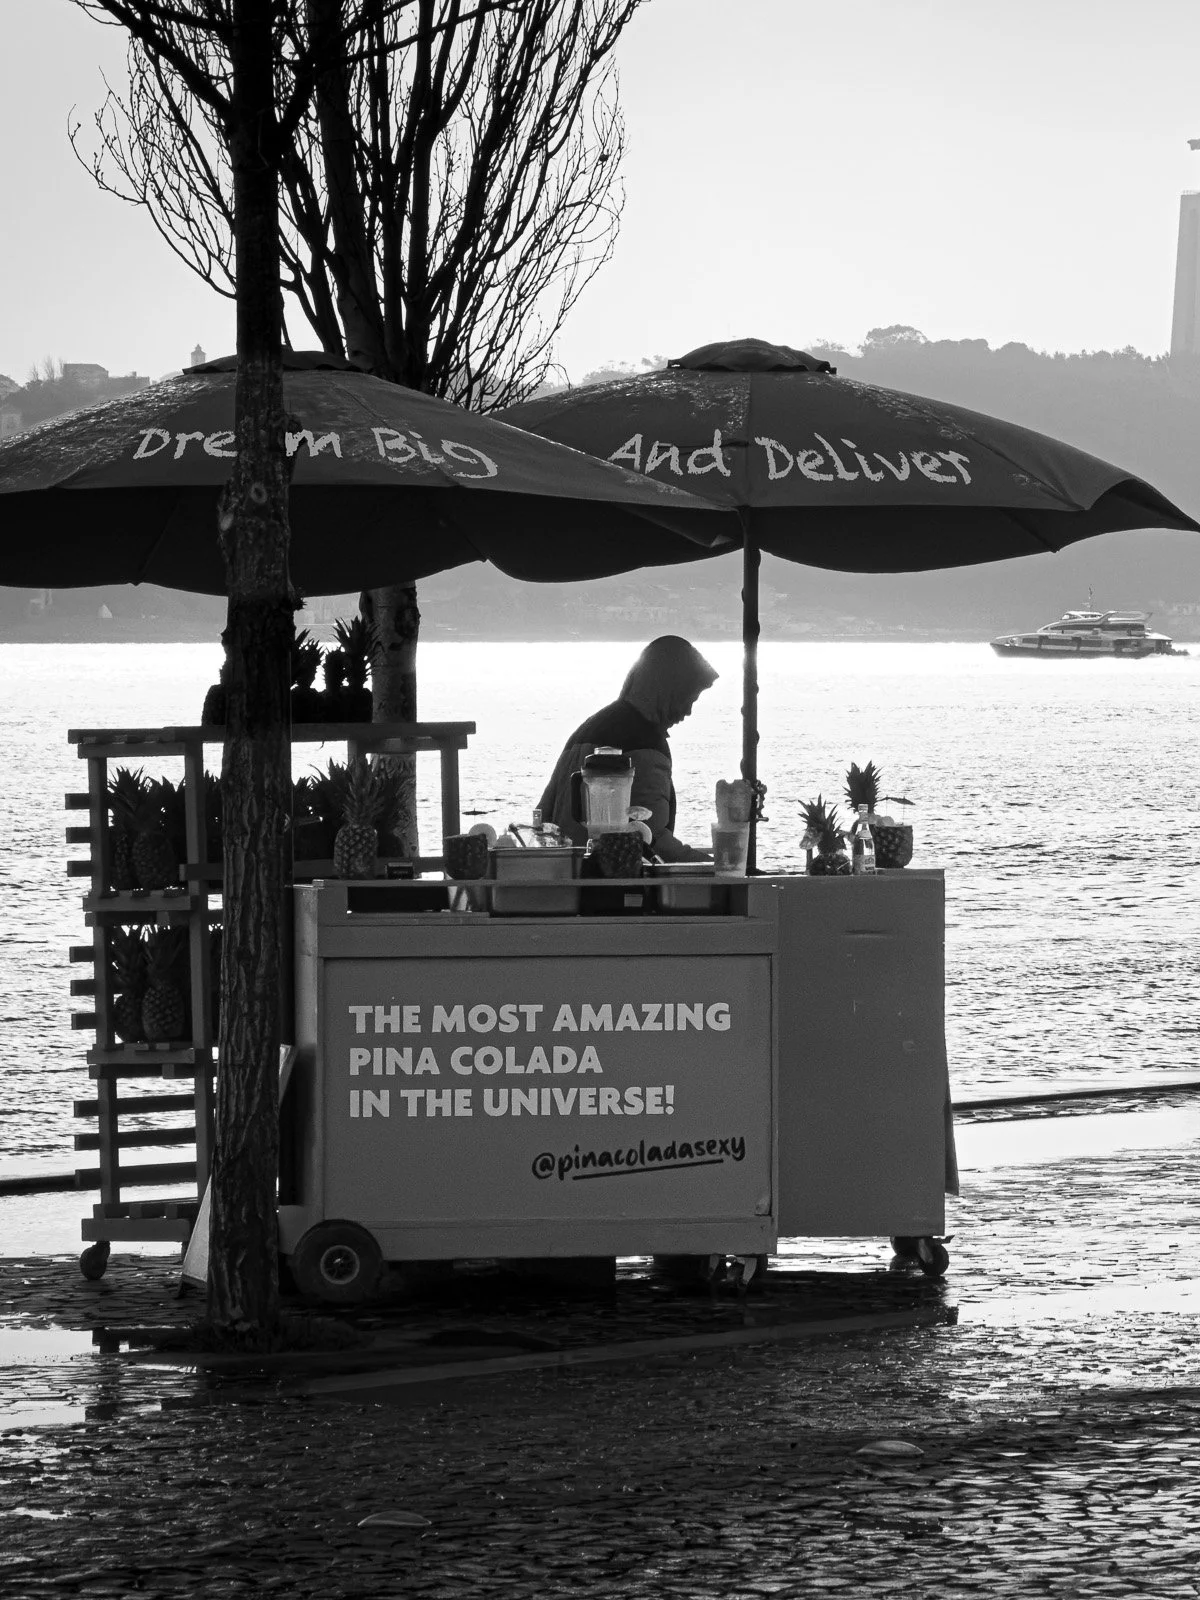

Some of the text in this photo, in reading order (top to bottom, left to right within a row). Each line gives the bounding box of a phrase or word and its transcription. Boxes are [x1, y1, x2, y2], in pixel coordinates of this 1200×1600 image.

[132, 426, 498, 479] Drem Big
[607, 429, 972, 484] And Deliver
[348, 1002, 731, 1034] THE MOST AMAZING
[349, 1045, 604, 1075] PINA COLADA
[349, 1084, 675, 1118] IN THE UNIVERSE!
[531, 1136, 746, 1181] @pinacoladasexy
